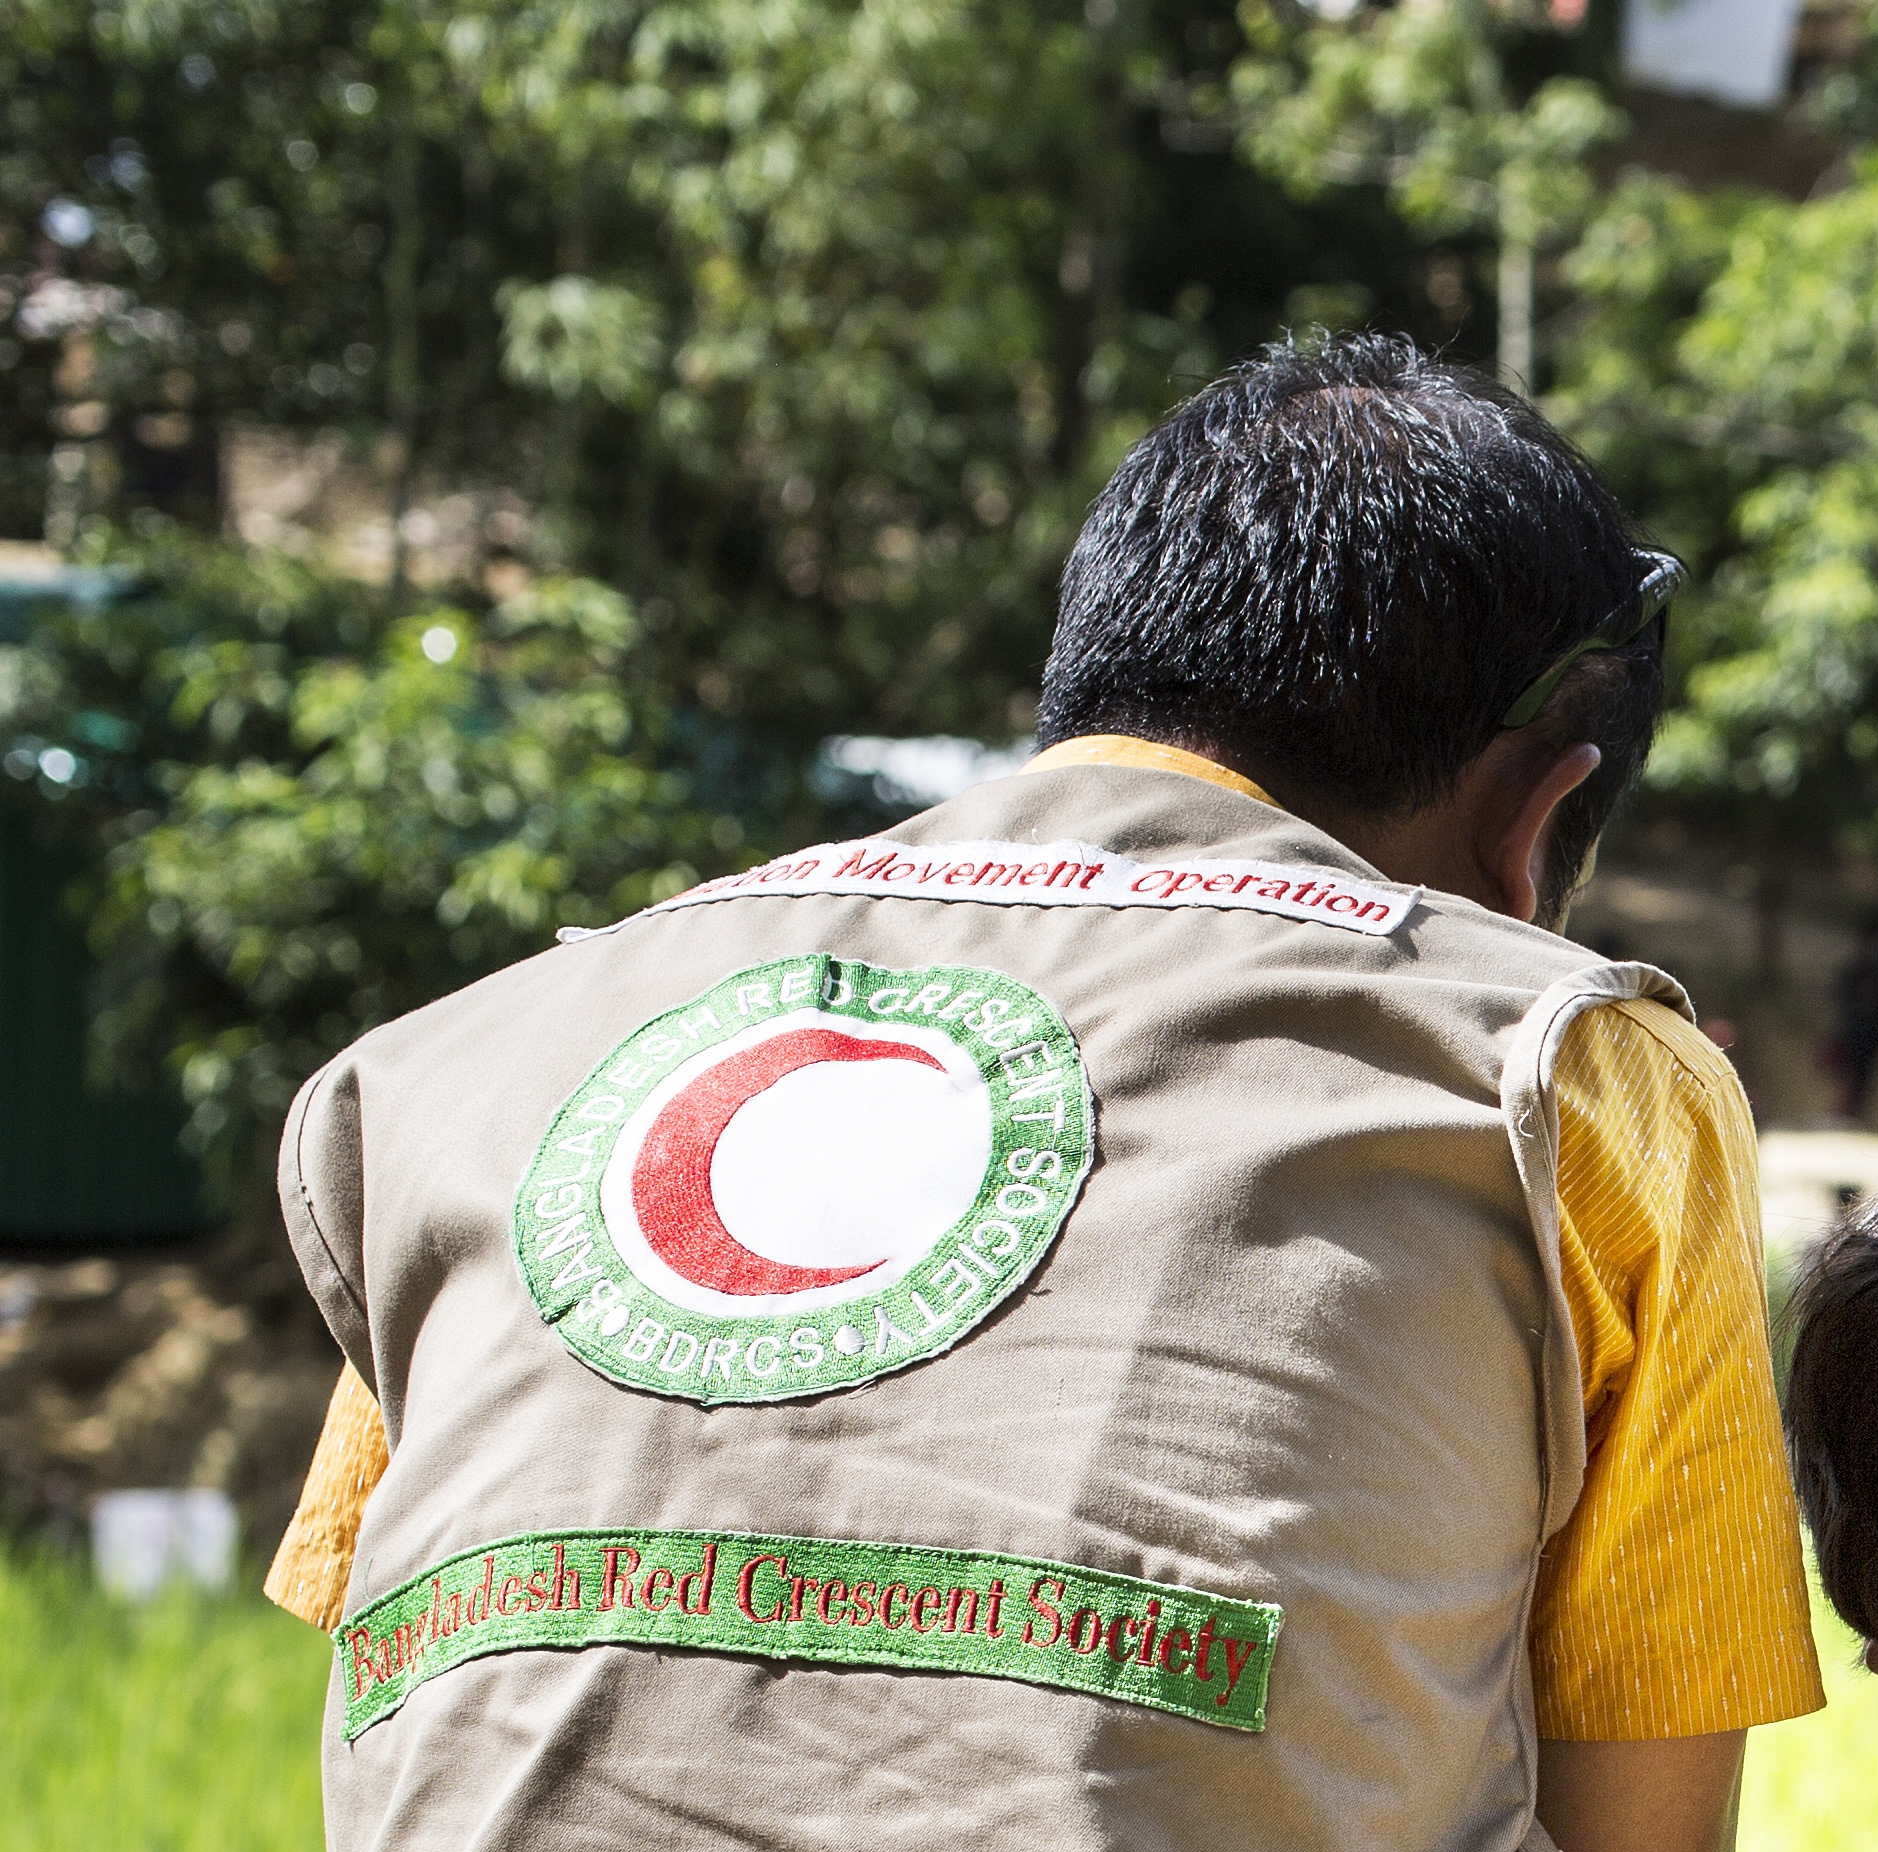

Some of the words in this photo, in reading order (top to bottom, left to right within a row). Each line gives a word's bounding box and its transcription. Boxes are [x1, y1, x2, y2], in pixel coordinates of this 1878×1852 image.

[832, 848, 1104, 890] Movement
[735, 966, 854, 1017] RED
[867, 983, 1067, 1132] CRESCENT
[533, 1005, 724, 1324] BANGLADESH
[873, 1147, 1062, 1355] SOCIETY
[621, 1316, 825, 1382] BDRCS
[347, 1543, 581, 1702] Bangladesh
[596, 1543, 718, 1616] Red
[736, 1554, 1008, 1639] Crescent
[1021, 1577, 1257, 1707] Society
